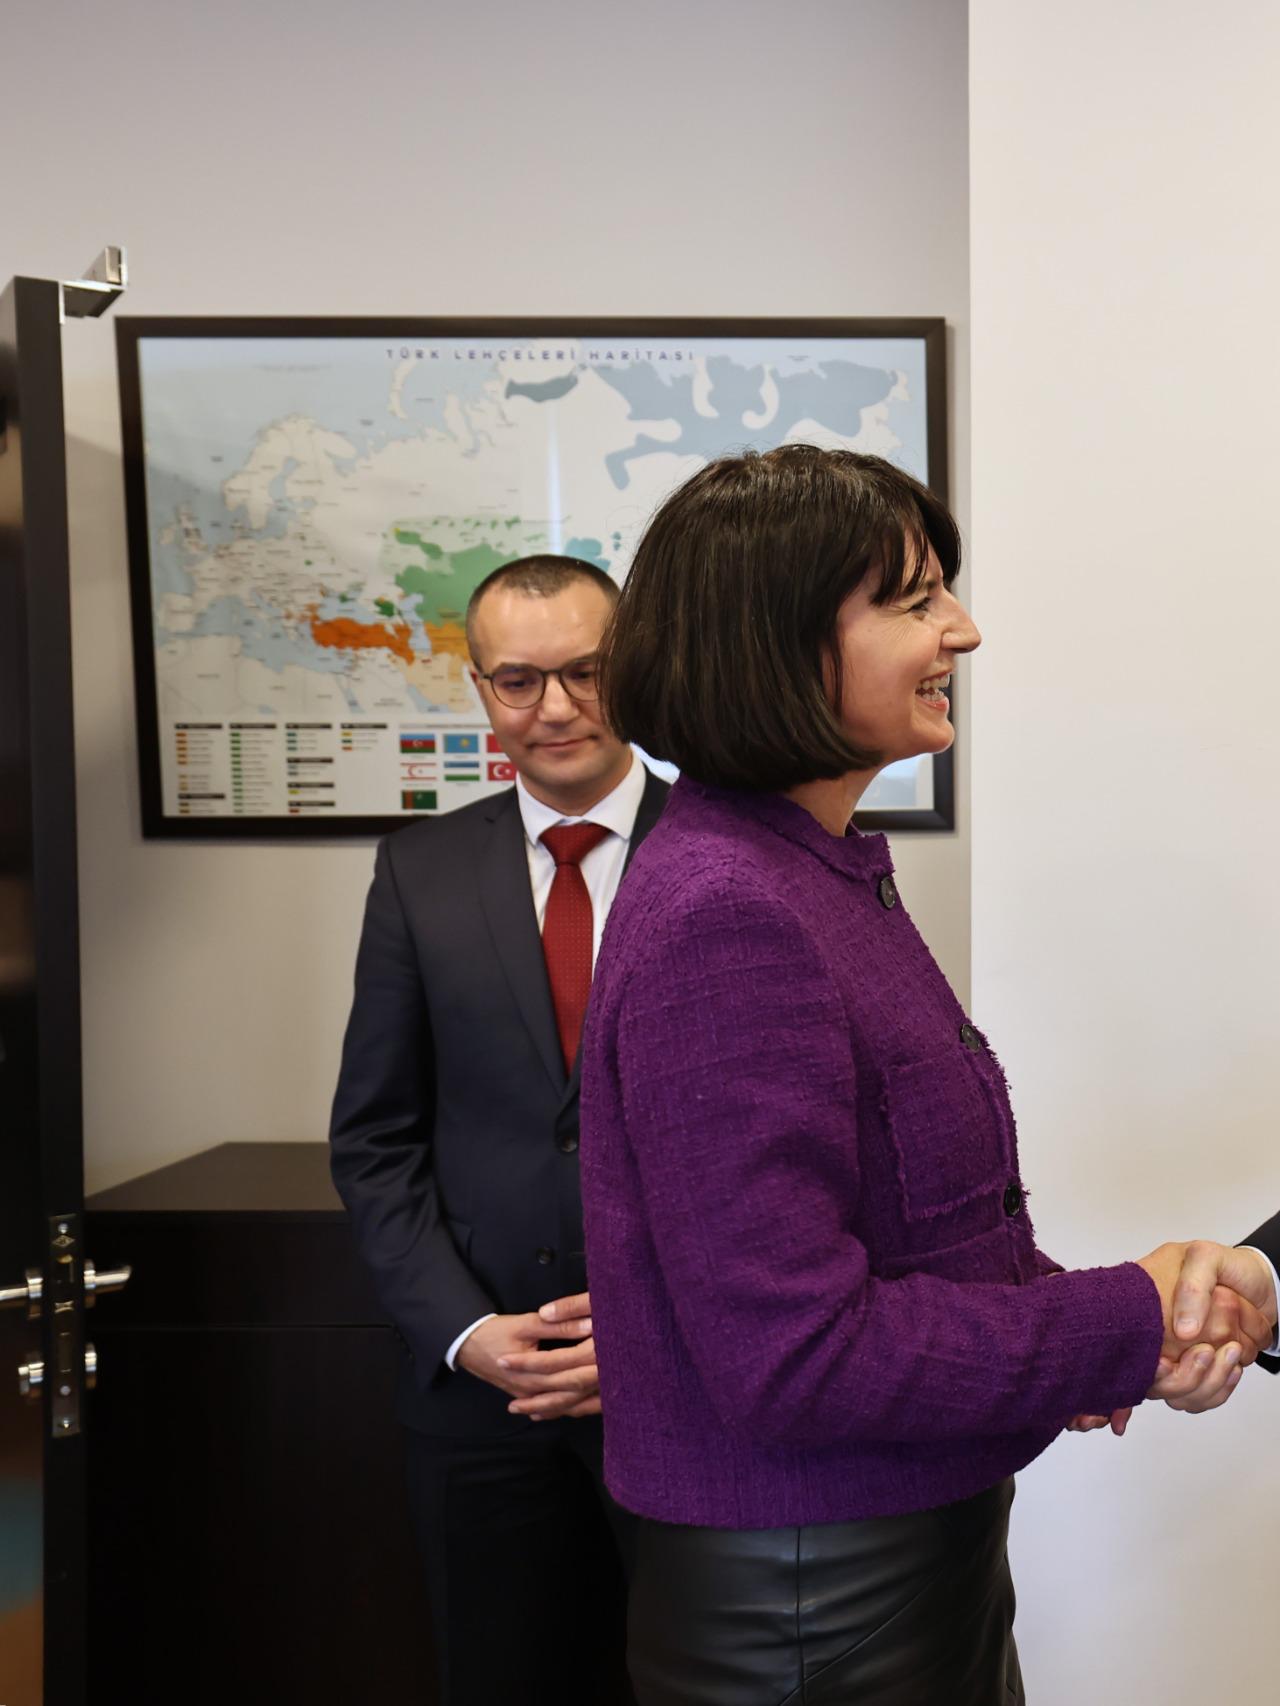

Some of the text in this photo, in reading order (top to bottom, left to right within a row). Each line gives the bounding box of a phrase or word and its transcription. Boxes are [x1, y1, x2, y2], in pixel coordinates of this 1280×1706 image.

[386, 346, 693, 361] TÜRK LEHÇELERİ HARİTASI
